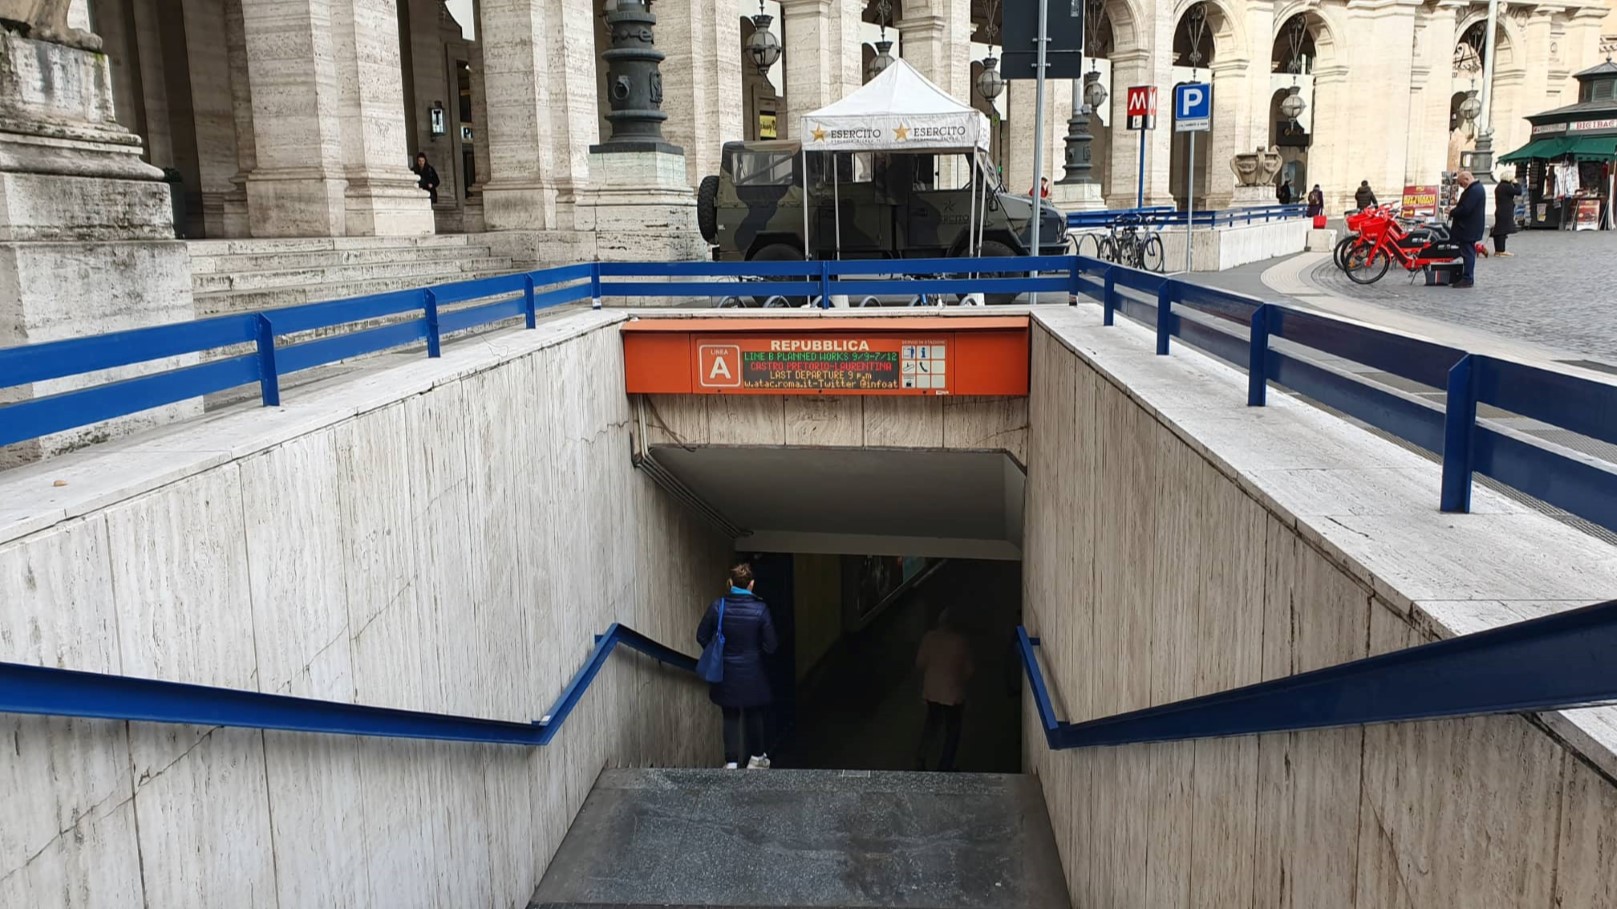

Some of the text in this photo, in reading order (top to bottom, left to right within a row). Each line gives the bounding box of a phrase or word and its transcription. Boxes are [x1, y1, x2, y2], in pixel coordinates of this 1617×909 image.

[1128, 91, 1147, 110] M
[1183, 88, 1203, 116] P
[830, 129, 882, 140] ESERCITO
[914, 126, 966, 138] ESERCITO
[770, 339, 870, 351] REPUBBLICA
[710, 348, 729, 356] LINEA
[744, 352, 898, 361] LINE B PLANNED WORKS 9/9-7/12
[709, 356, 732, 380] A
[751, 361, 784, 371] CASTRO
[769, 370, 793, 380] LAST
[795, 370, 845, 380] DEPARTURE
[848, 370, 854, 380] 9
